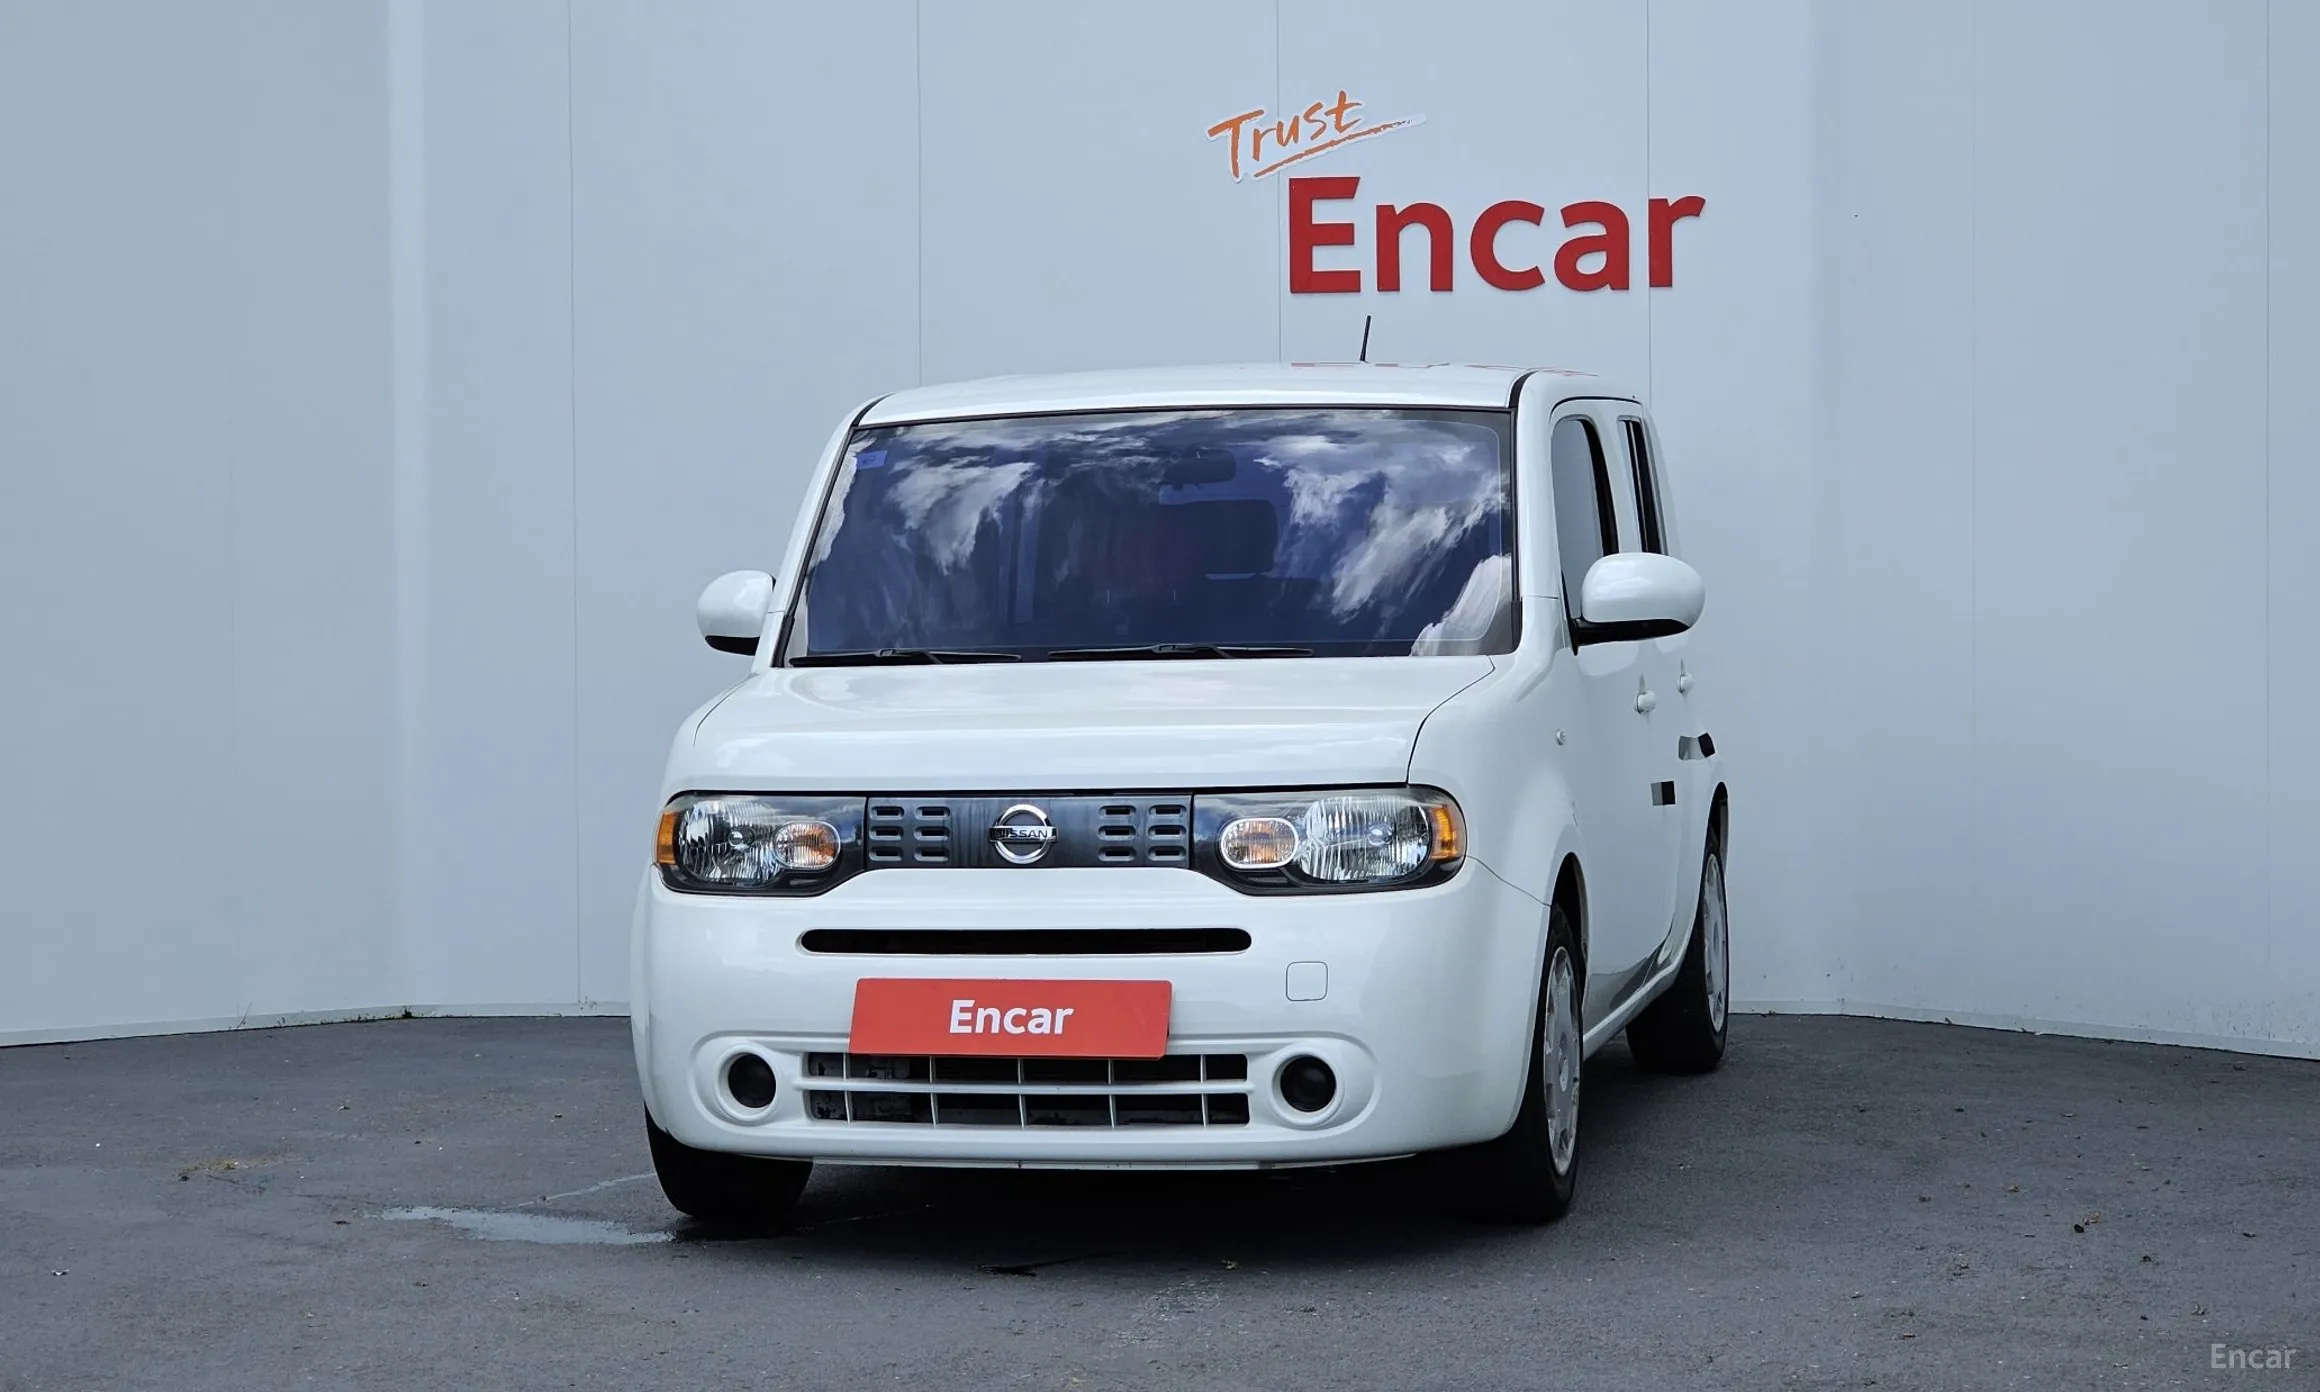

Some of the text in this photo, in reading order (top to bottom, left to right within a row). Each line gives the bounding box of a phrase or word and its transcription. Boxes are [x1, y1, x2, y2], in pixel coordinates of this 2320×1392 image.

[1207, 90, 1363, 177] Trust
[1288, 176, 1707, 293] Encar
[950, 1000, 1074, 1034] Encar
